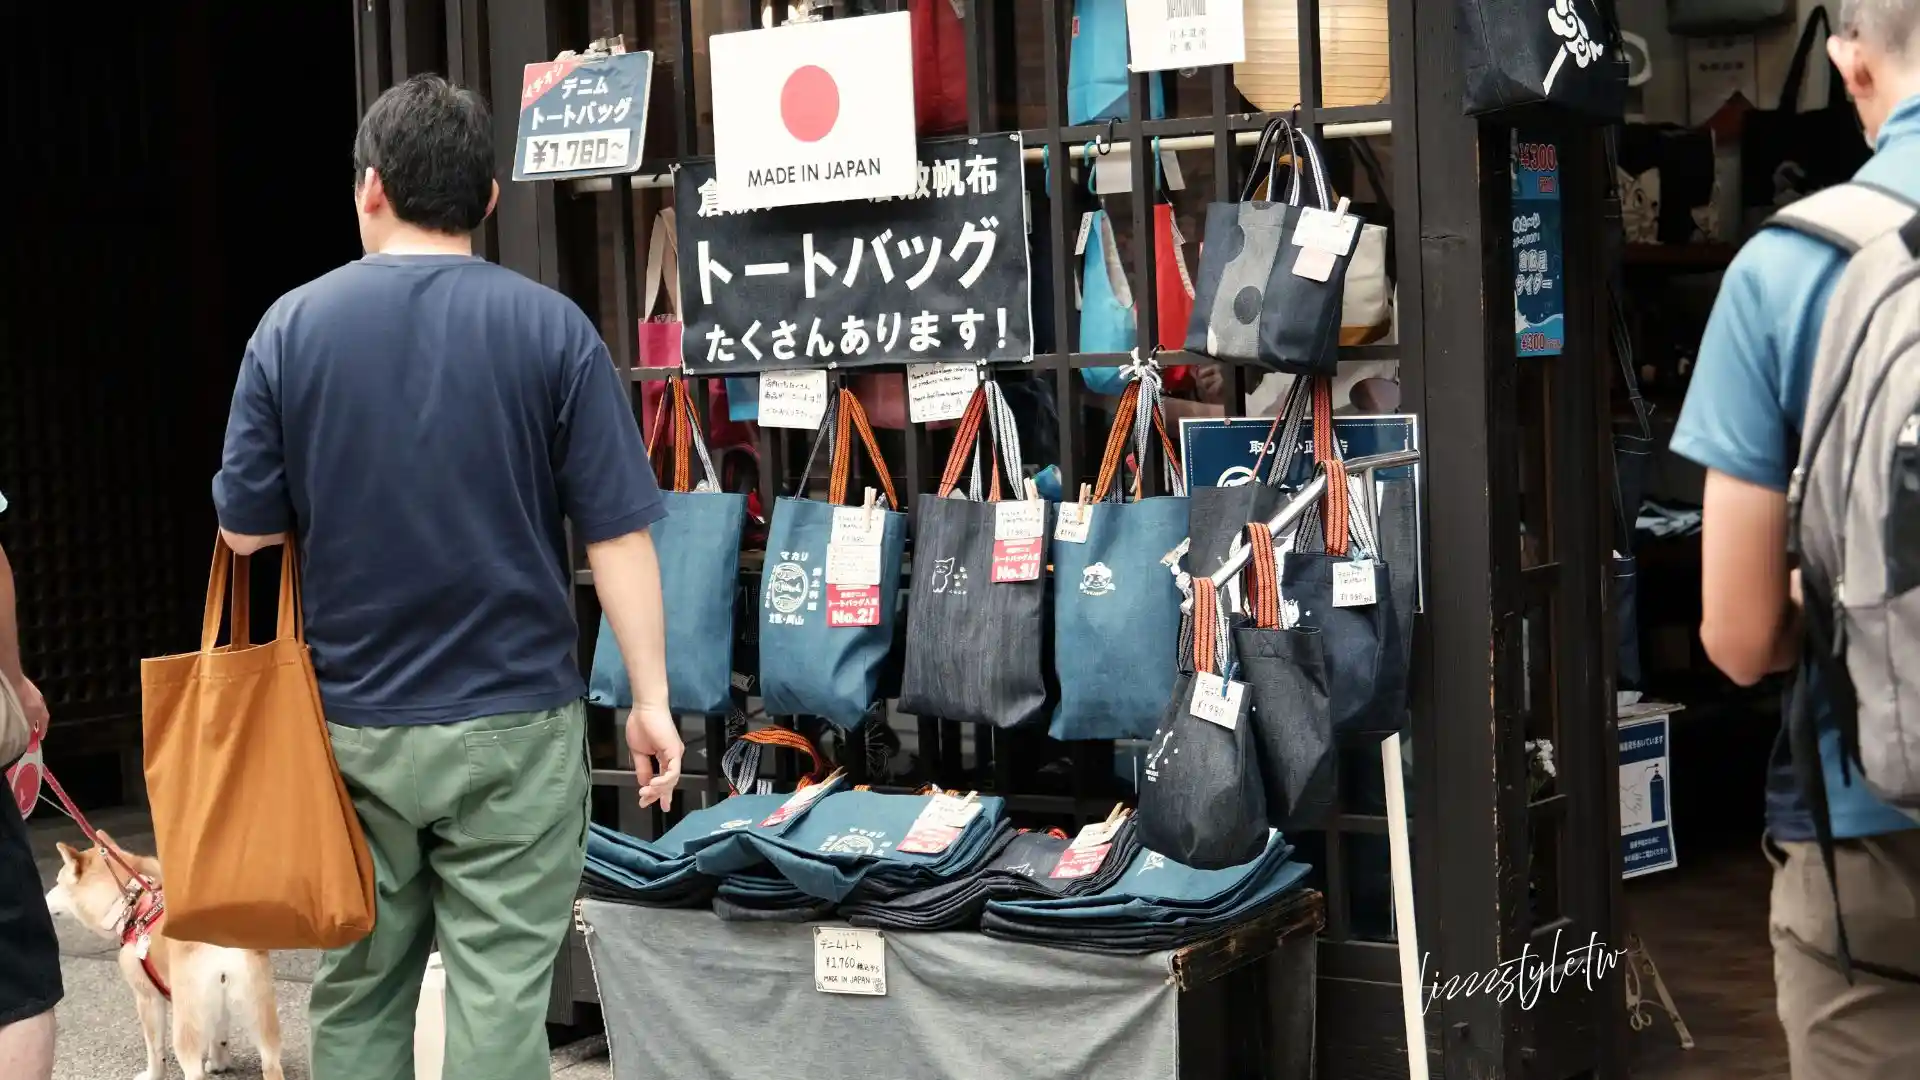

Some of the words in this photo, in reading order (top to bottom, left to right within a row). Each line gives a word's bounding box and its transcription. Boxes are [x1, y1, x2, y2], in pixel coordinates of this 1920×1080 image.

[561, 76, 609, 99] デニム
[531, 97, 632, 130] トートバッグ
[748, 165, 796, 188] MADE
[801, 162, 819, 182] IN
[824, 157, 881, 180] JAPAN
[698, 216, 1000, 305] トートバッグ
[705, 307, 1007, 362] たくさんあります!
[831, 608, 875, 625] No.2!
[820, 938, 862, 950] デニムトート
[823, 975, 838, 983] MADE
[840, 976, 848, 984] IN
[849, 976, 871, 985] JAPAN
